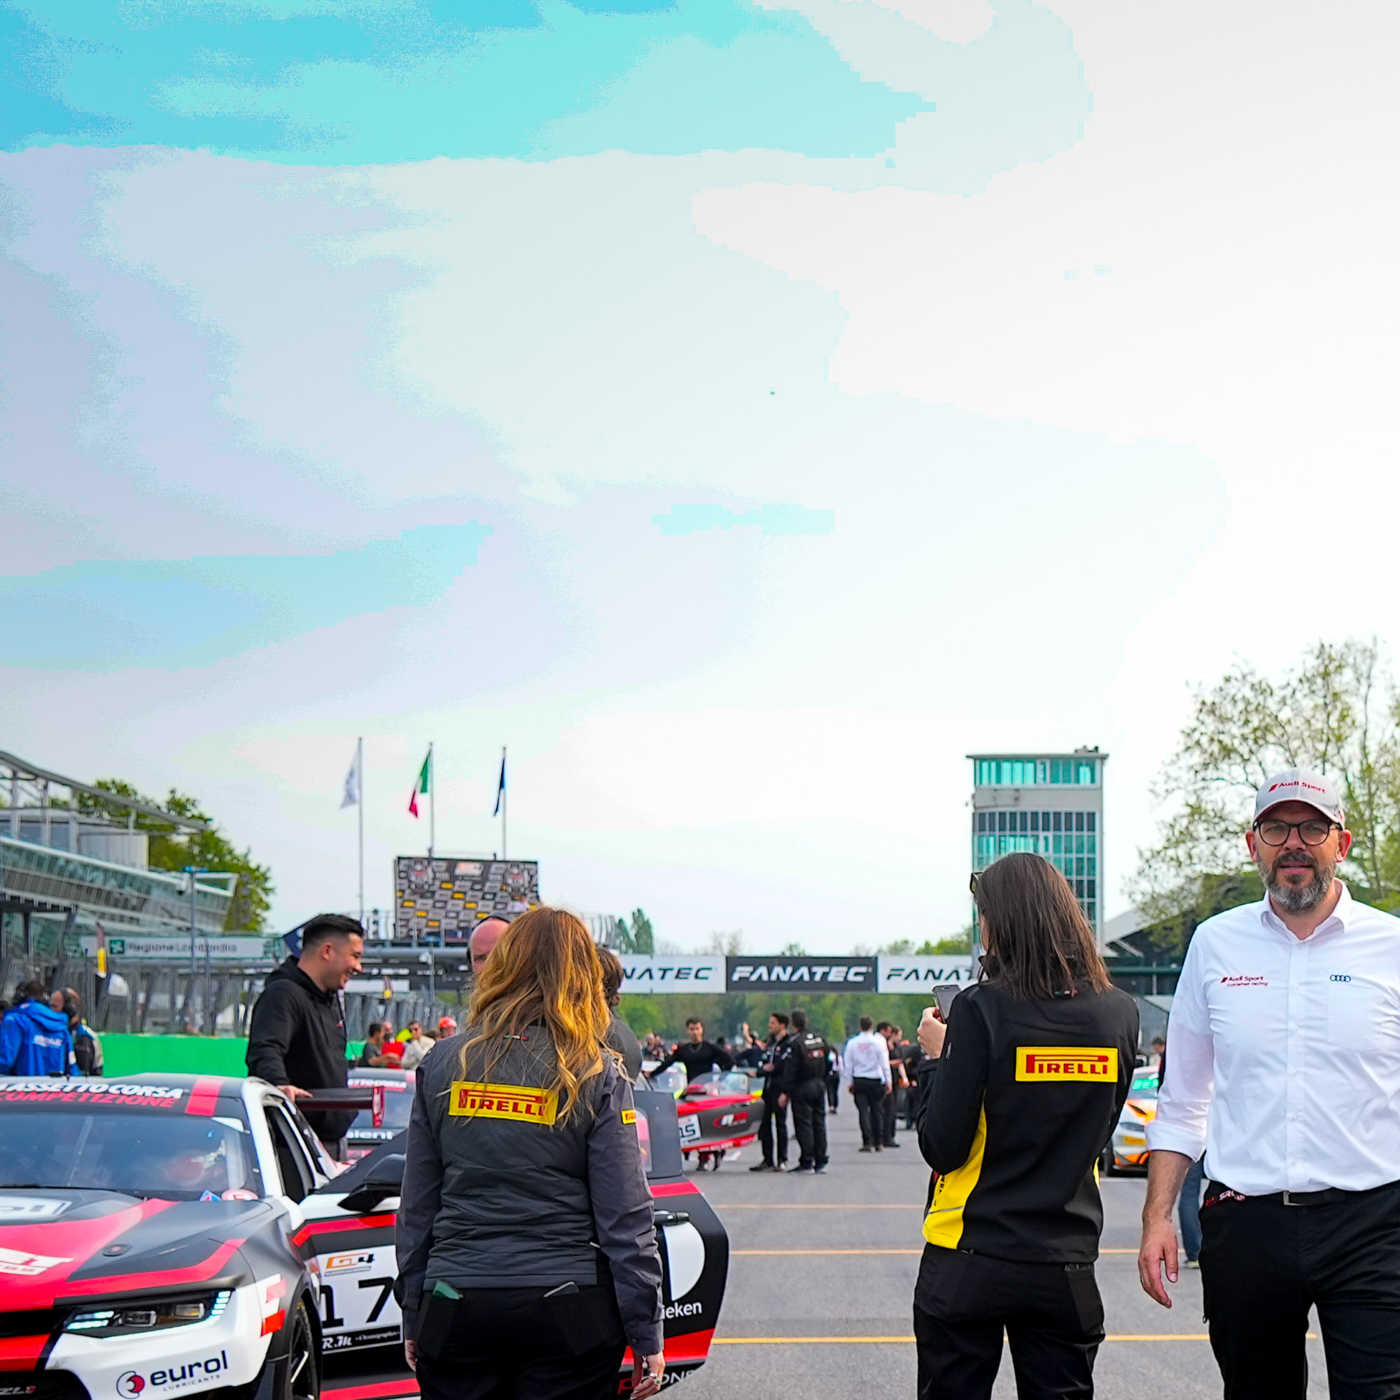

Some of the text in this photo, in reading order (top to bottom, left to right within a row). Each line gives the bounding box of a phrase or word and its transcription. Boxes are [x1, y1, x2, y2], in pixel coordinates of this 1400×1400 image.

[624, 966, 713, 980] NATEC
[731, 965, 868, 982] FANATEC
[886, 967, 974, 981] FANAT
[1025, 1054, 1109, 1075] PIRELLI
[6, 1082, 184, 1099] ASSETTO CORSA
[458, 1088, 548, 1117] PIRELLI
[150, 1350, 229, 1387] eurol
